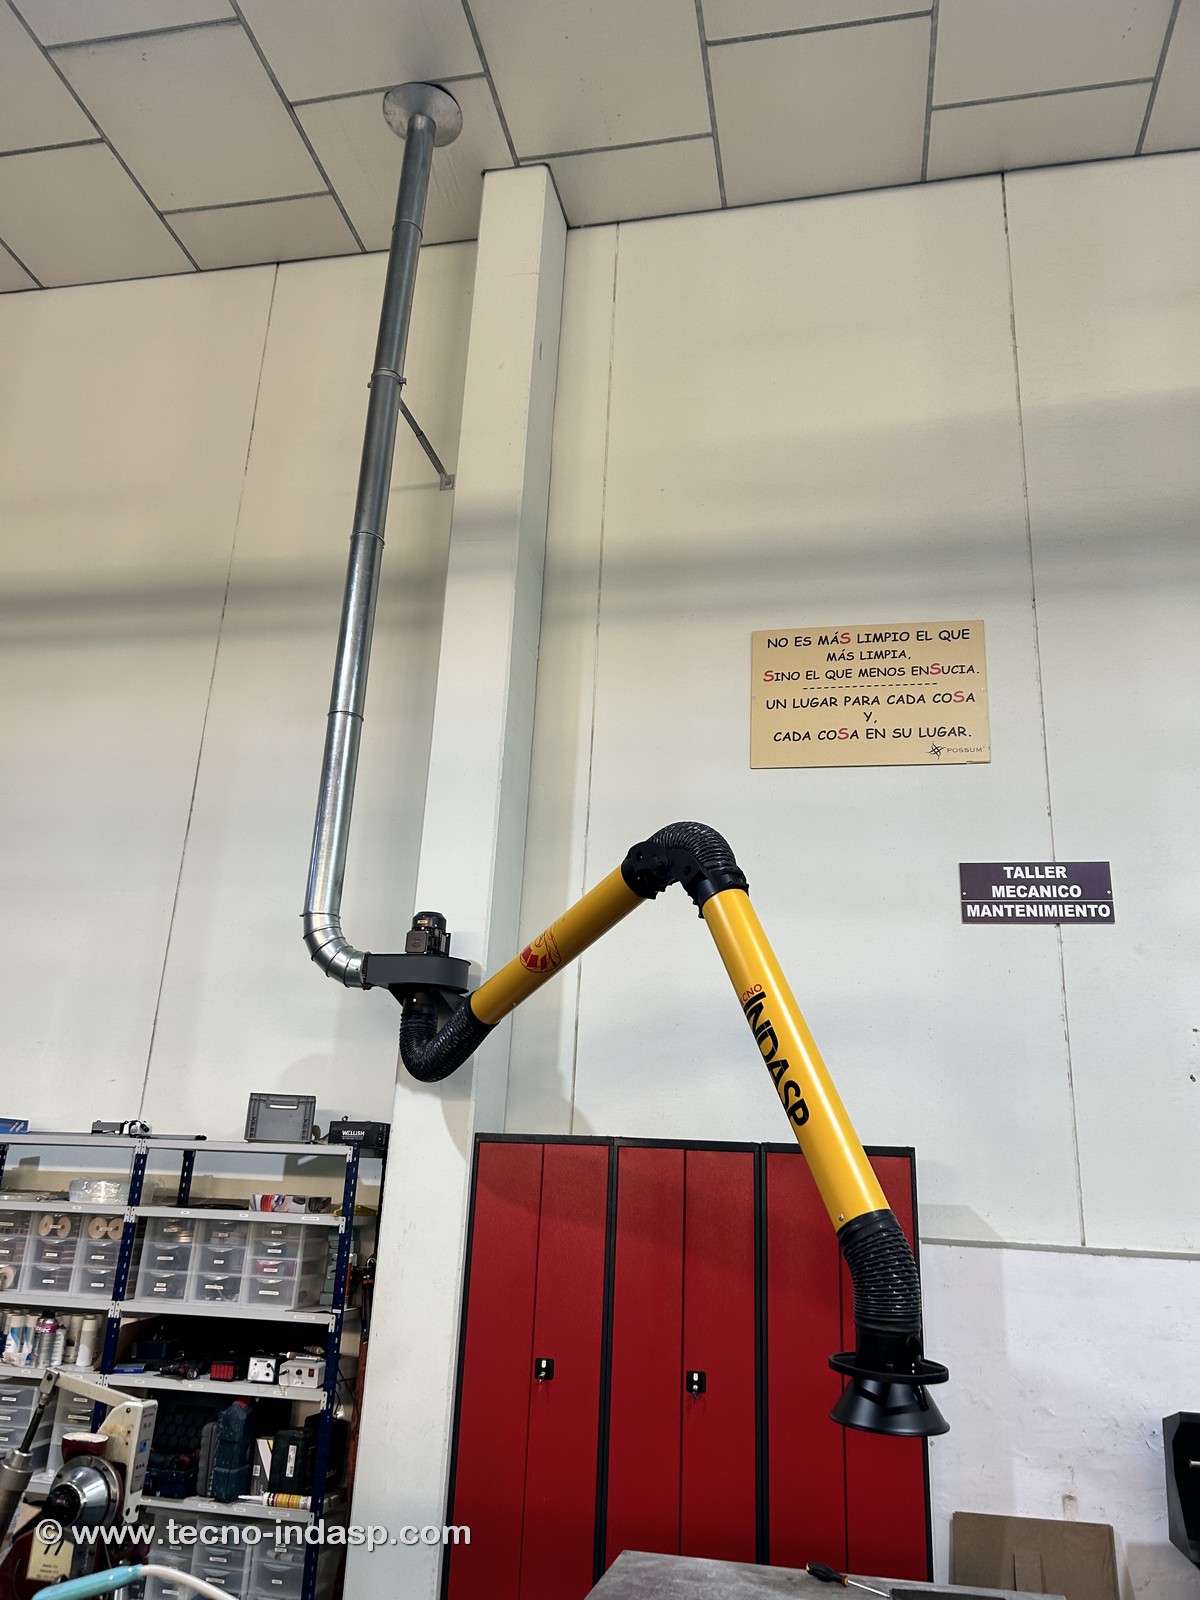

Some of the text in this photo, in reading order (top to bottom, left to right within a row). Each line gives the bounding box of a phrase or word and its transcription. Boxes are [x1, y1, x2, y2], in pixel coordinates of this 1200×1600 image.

[767, 629, 970, 648] NO ES MÁS LIMPIO EL QUE
[827, 649, 911, 661] MÁS LIMPIA,
[763, 663, 980, 682] SINO EL QUE MENOS ENSUCIA.
[766, 691, 975, 709] UN LUGAR PARA CADA COSA
[863, 712, 877, 724] Y,
[773, 726, 971, 742] CADA COSA EN SU LUGAR.
[1003, 866, 1068, 879] TALLER
[991, 885, 1082, 898] MECANICO
[966, 904, 1110, 917] MANTENIMIENTO
[744, 991, 809, 1126] INDASP
